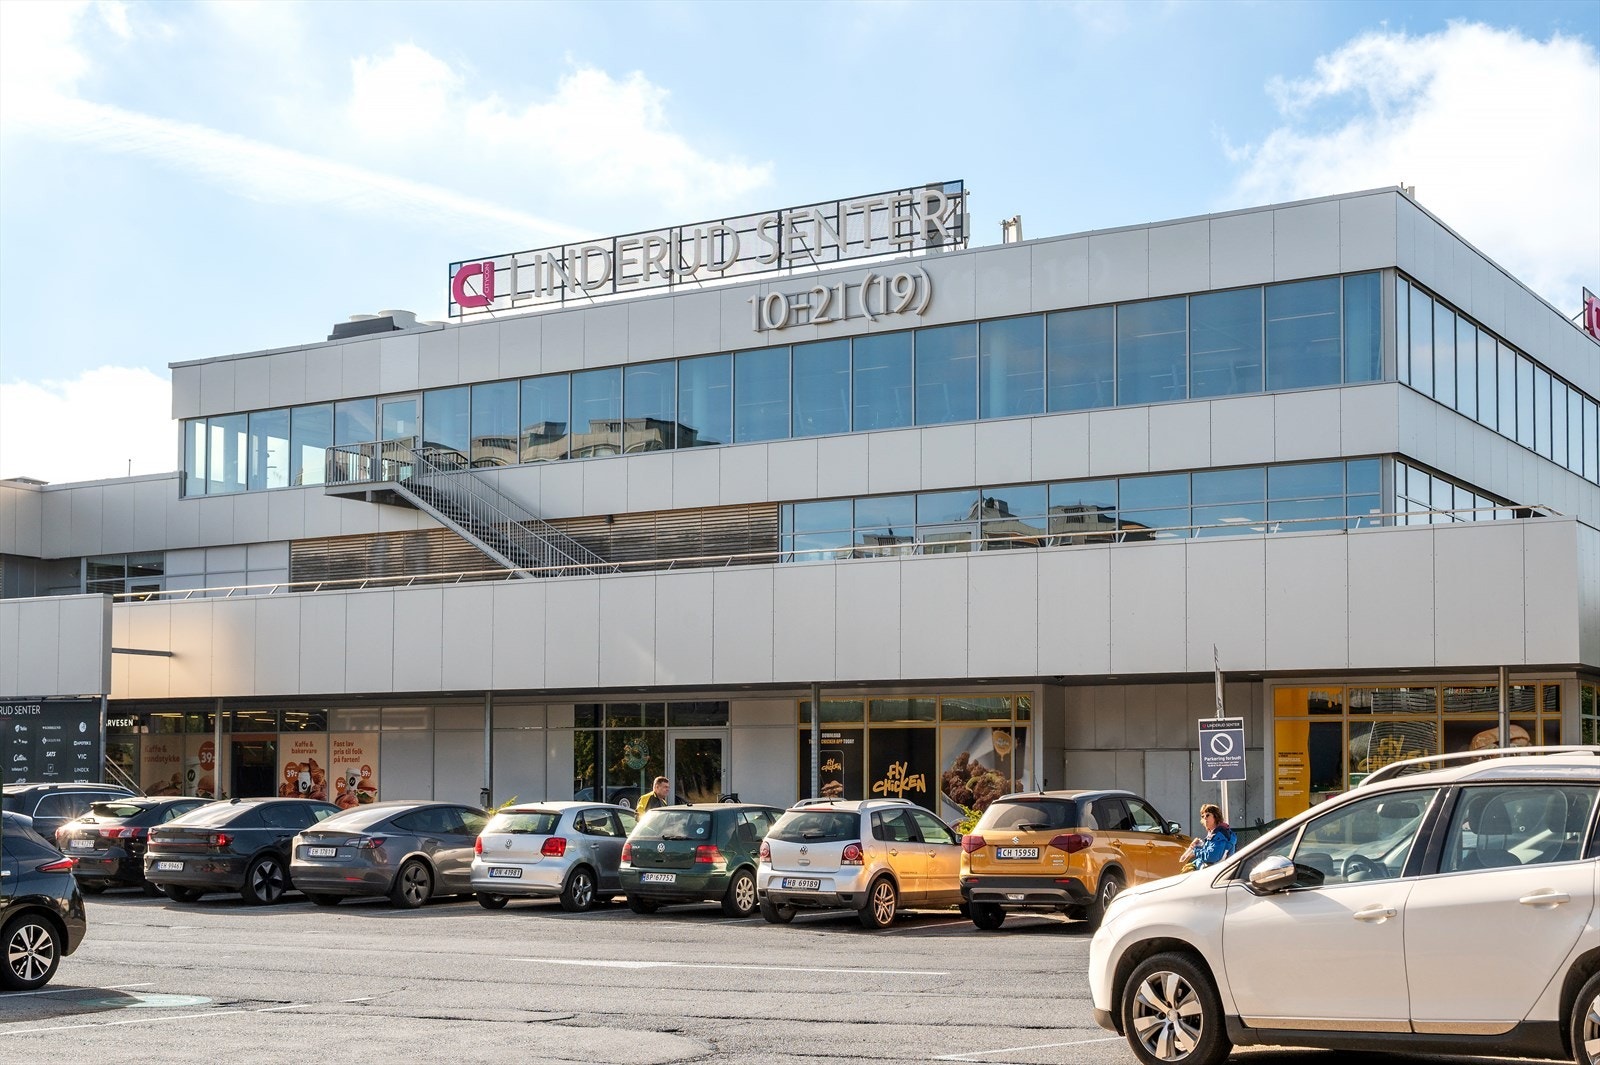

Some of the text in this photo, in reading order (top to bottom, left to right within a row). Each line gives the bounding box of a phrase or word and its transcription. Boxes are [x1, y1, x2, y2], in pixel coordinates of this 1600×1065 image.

[510, 189, 952, 300] LINDERUD SENTER
[747, 280, 847, 332] 10-21
[859, 265, 932, 322] (19)
[14, 705, 41, 715] SENTER
[144, 744, 161, 753] Kaffe
[334, 748, 344, 756] pris
[334, 756, 340, 764] på
[1002, 848, 1036, 857] CH 15958
